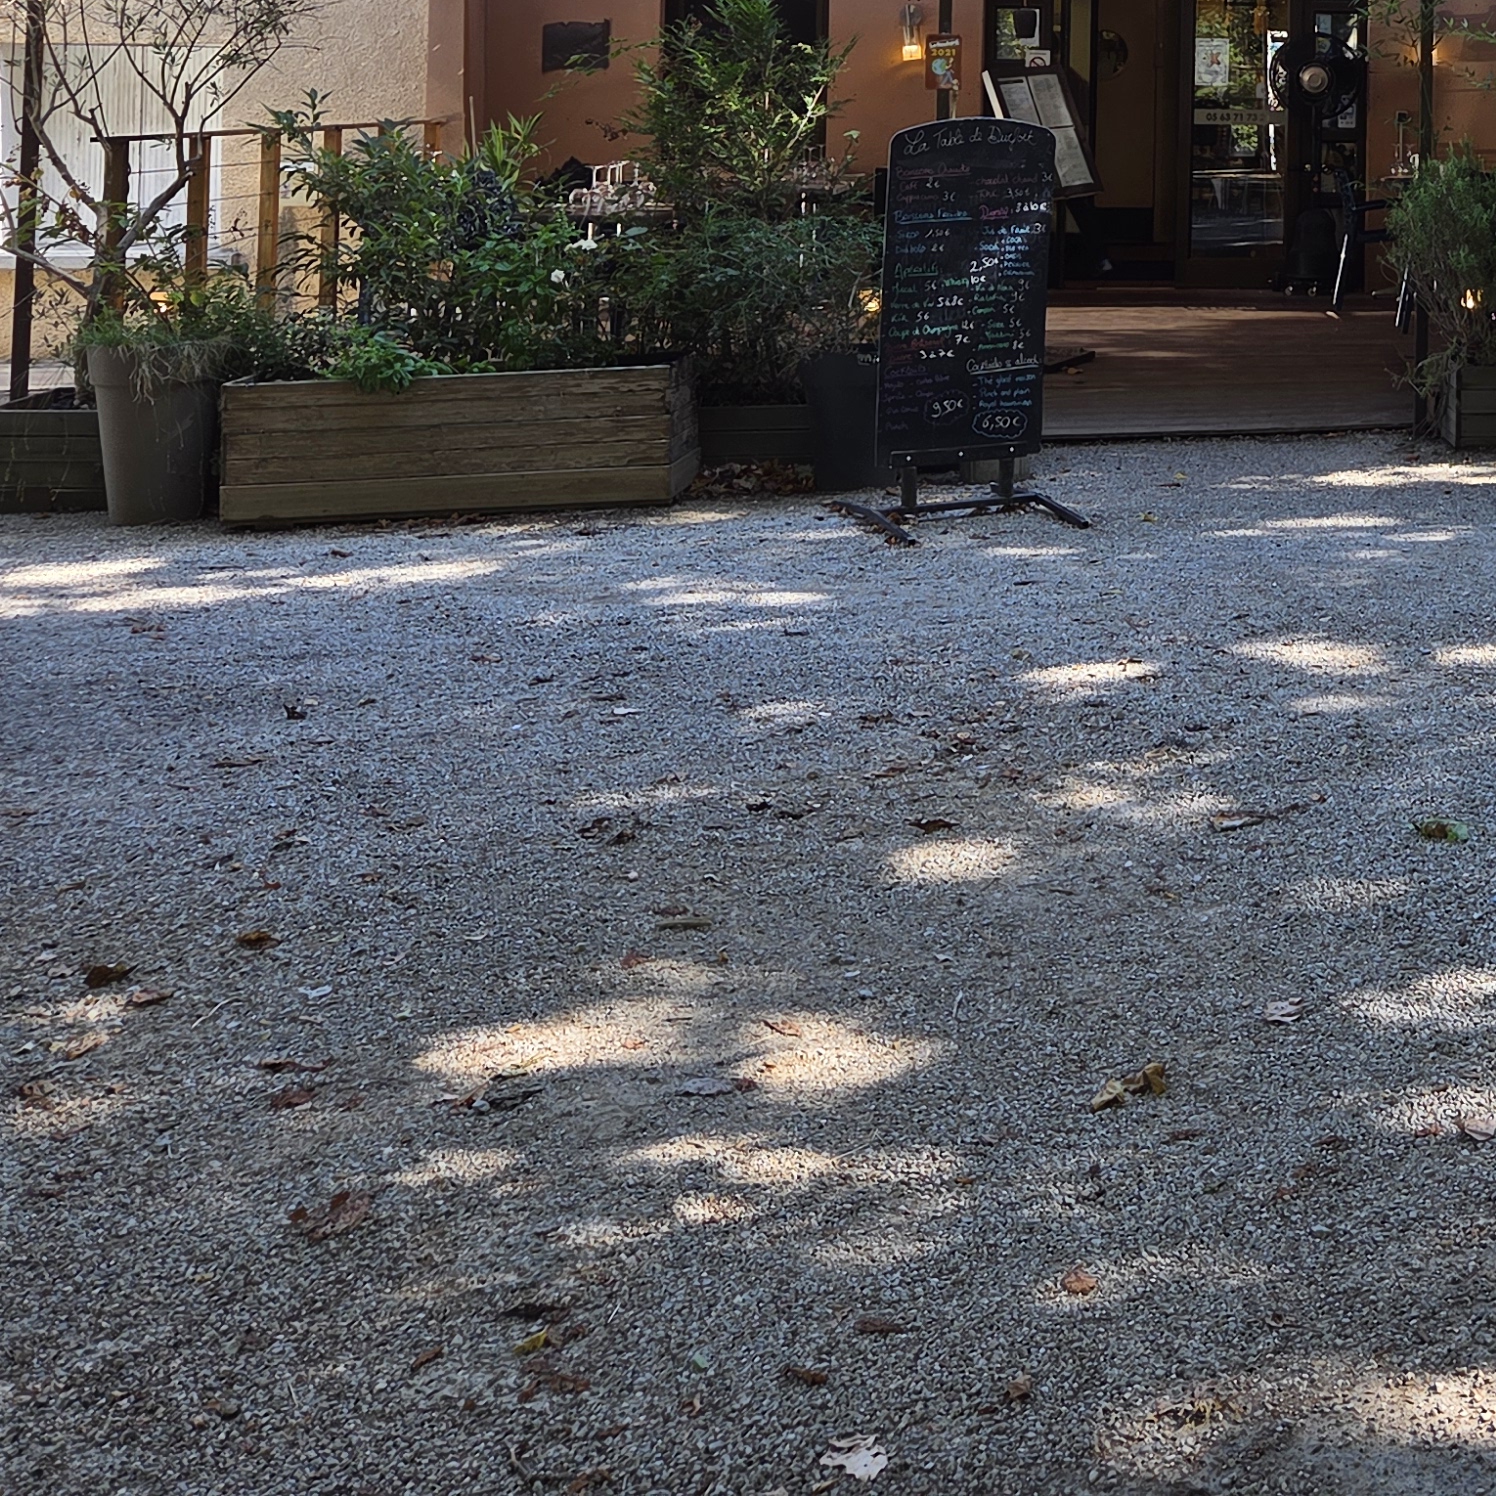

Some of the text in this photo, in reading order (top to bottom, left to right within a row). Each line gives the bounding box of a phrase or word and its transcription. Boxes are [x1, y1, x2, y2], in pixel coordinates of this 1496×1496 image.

[930, 48, 956, 56] 2021
[1220, 112, 1231, 122] 63
[1233, 112, 1243, 122] 71
[903, 130, 930, 155] La
[982, 414, 1021, 431] 6,50€
